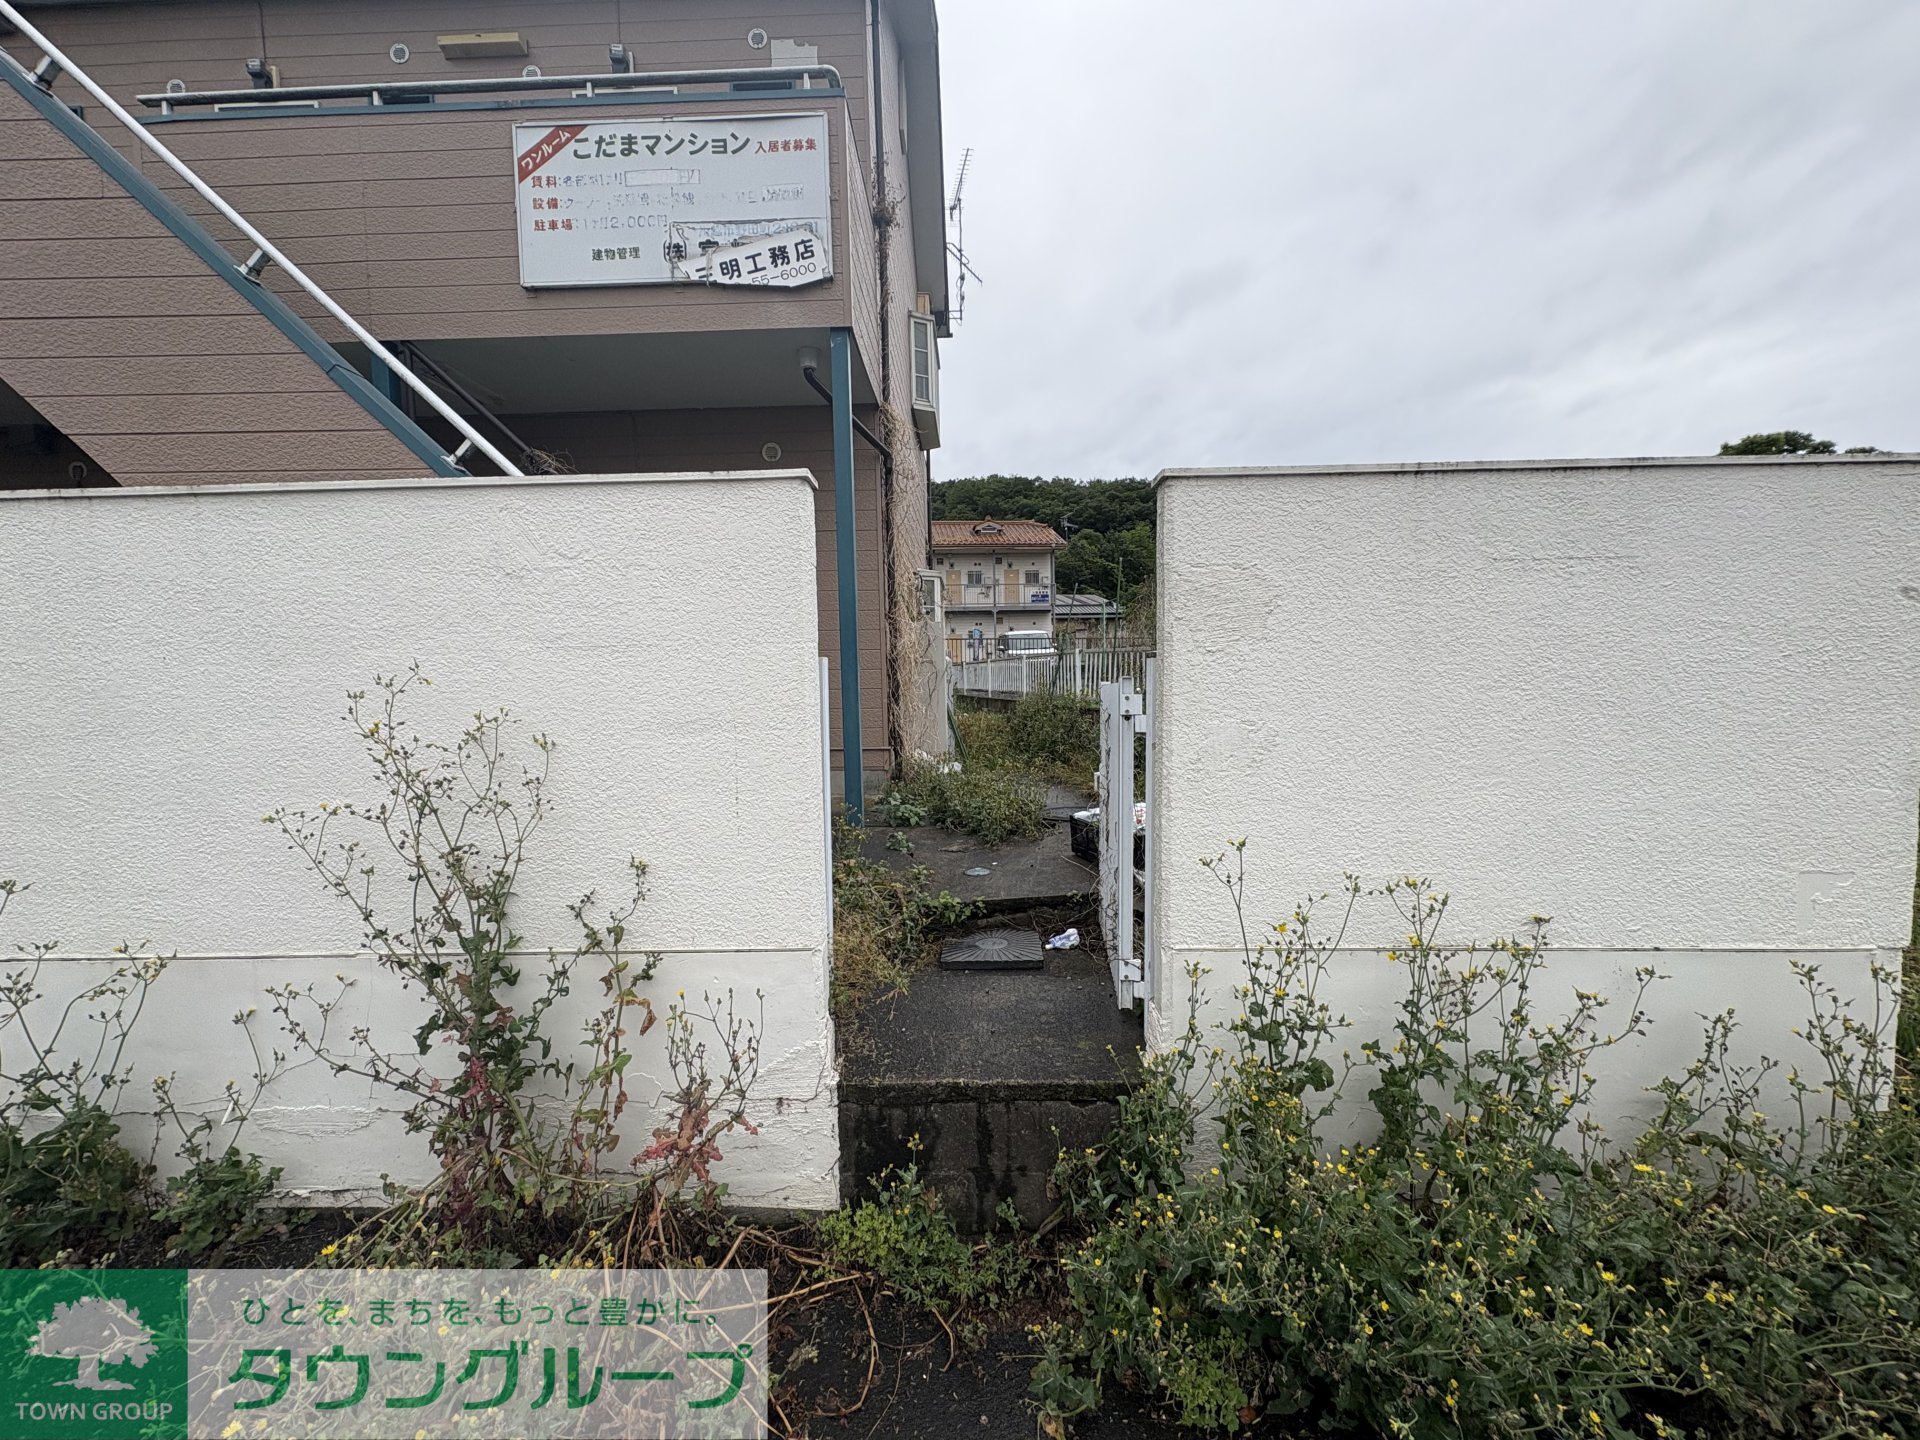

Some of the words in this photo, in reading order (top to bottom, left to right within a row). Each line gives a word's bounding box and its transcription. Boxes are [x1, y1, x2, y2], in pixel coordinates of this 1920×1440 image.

[520, 127, 573, 171] ワンルーム
[572, 131, 751, 160] こだまマンション
[754, 138, 817, 154] 入居者募集
[591, 246, 641, 261] 建物管理
